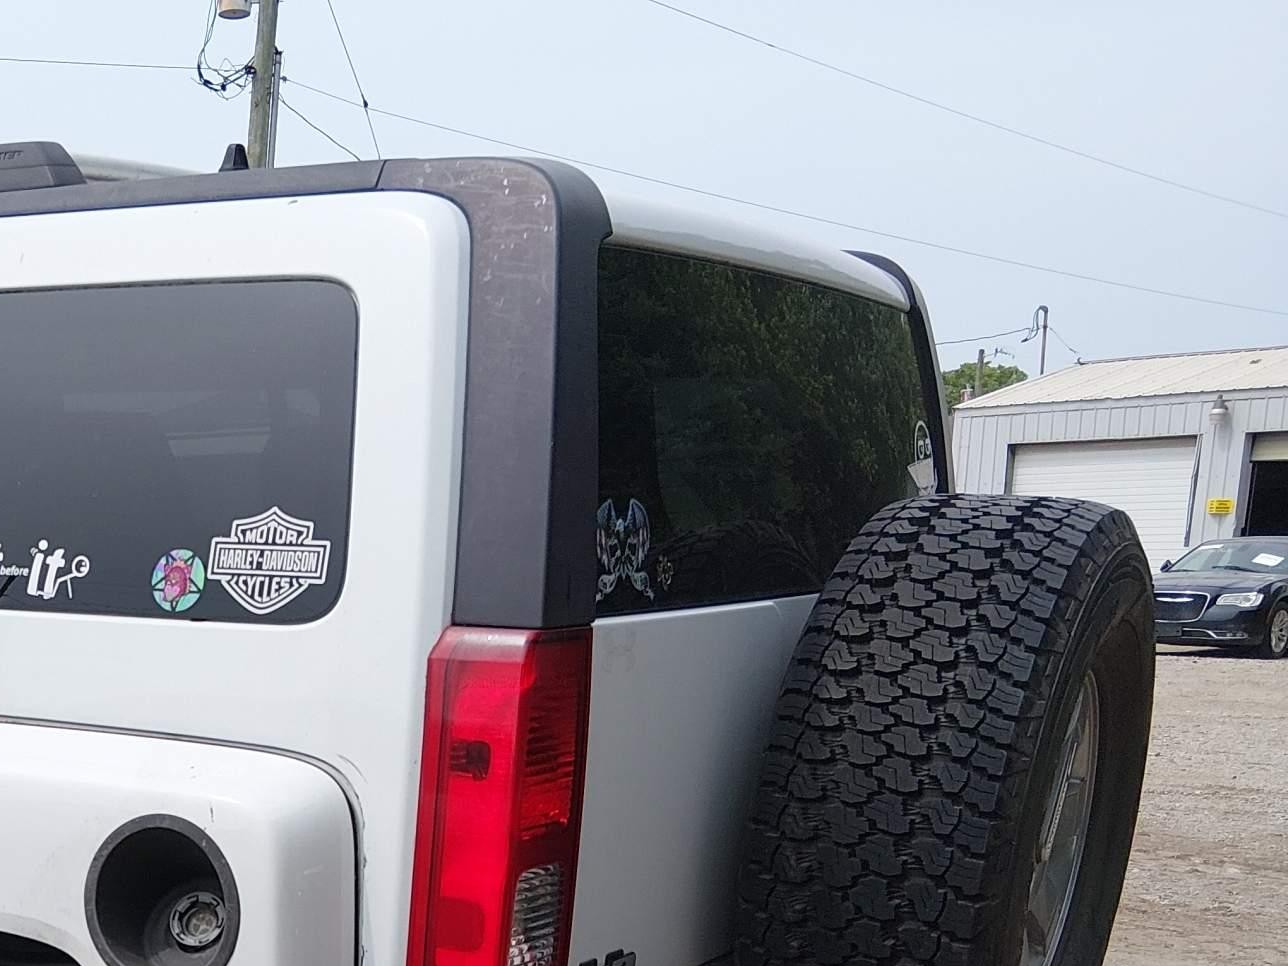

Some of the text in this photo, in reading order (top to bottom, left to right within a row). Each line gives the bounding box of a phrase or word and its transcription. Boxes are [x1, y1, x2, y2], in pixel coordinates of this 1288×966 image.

[244, 521, 298, 544] MOTOR
[0, 564, 29, 576] before
[218, 548, 318, 573] HARLEY-DAVIDSON
[237, 576, 290, 602] CYCLES
